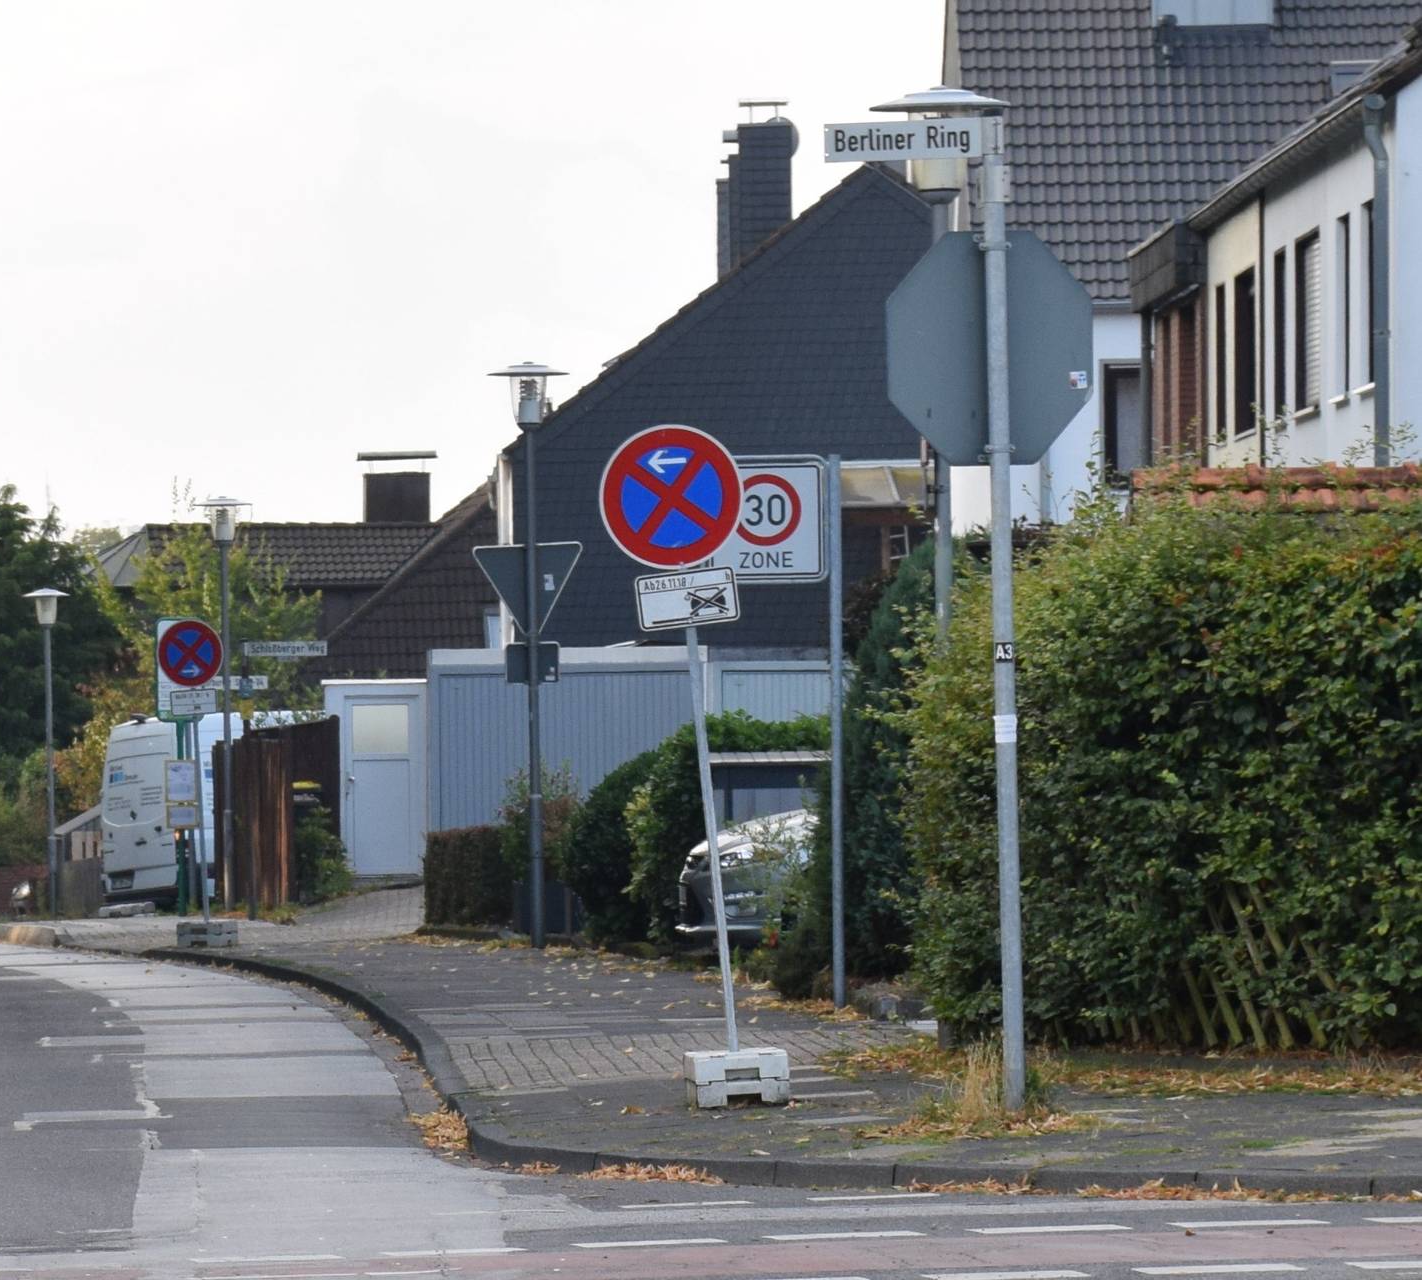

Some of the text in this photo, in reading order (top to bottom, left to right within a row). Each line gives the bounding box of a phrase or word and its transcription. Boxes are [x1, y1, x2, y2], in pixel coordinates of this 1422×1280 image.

[833, 125, 971, 153] Berliner Ring
[744, 493, 787, 527] 30
[739, 551, 794, 569] ZONE
[995, 643, 1013, 660] A3
